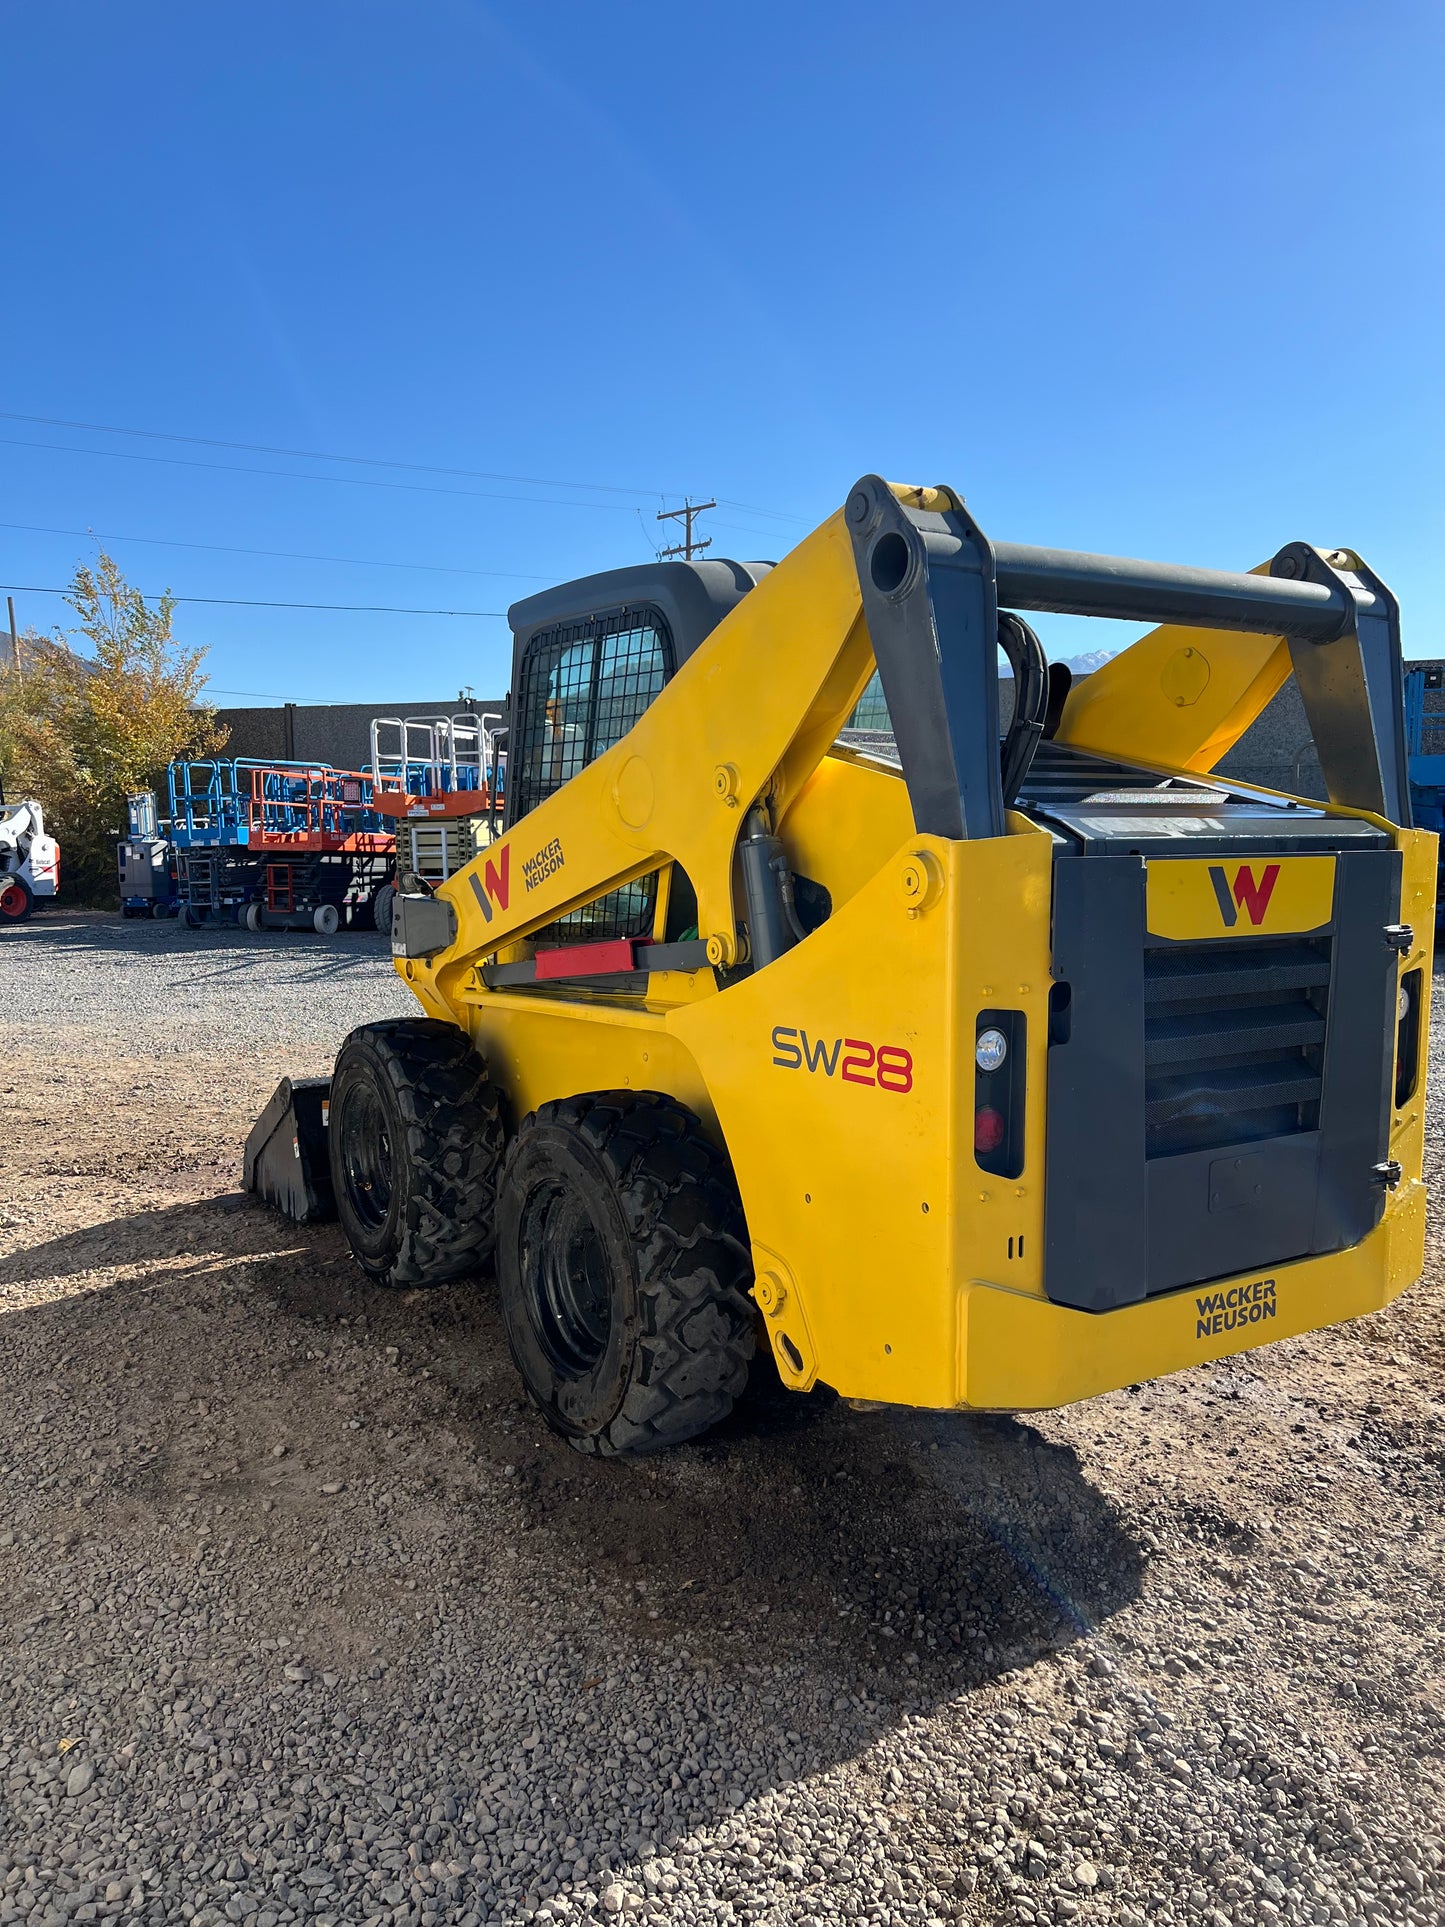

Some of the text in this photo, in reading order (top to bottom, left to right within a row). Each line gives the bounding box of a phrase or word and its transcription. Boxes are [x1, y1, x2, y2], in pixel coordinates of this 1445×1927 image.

[522, 837, 563, 877] WACKER
[525, 851, 565, 893] NEUSON
[468, 843, 510, 924] W
[1208, 864, 1281, 927] W
[772, 1026, 913, 1094] SW28
[1196, 1279, 1276, 1317] WACKER
[1196, 1299, 1277, 1339] NEUSON
